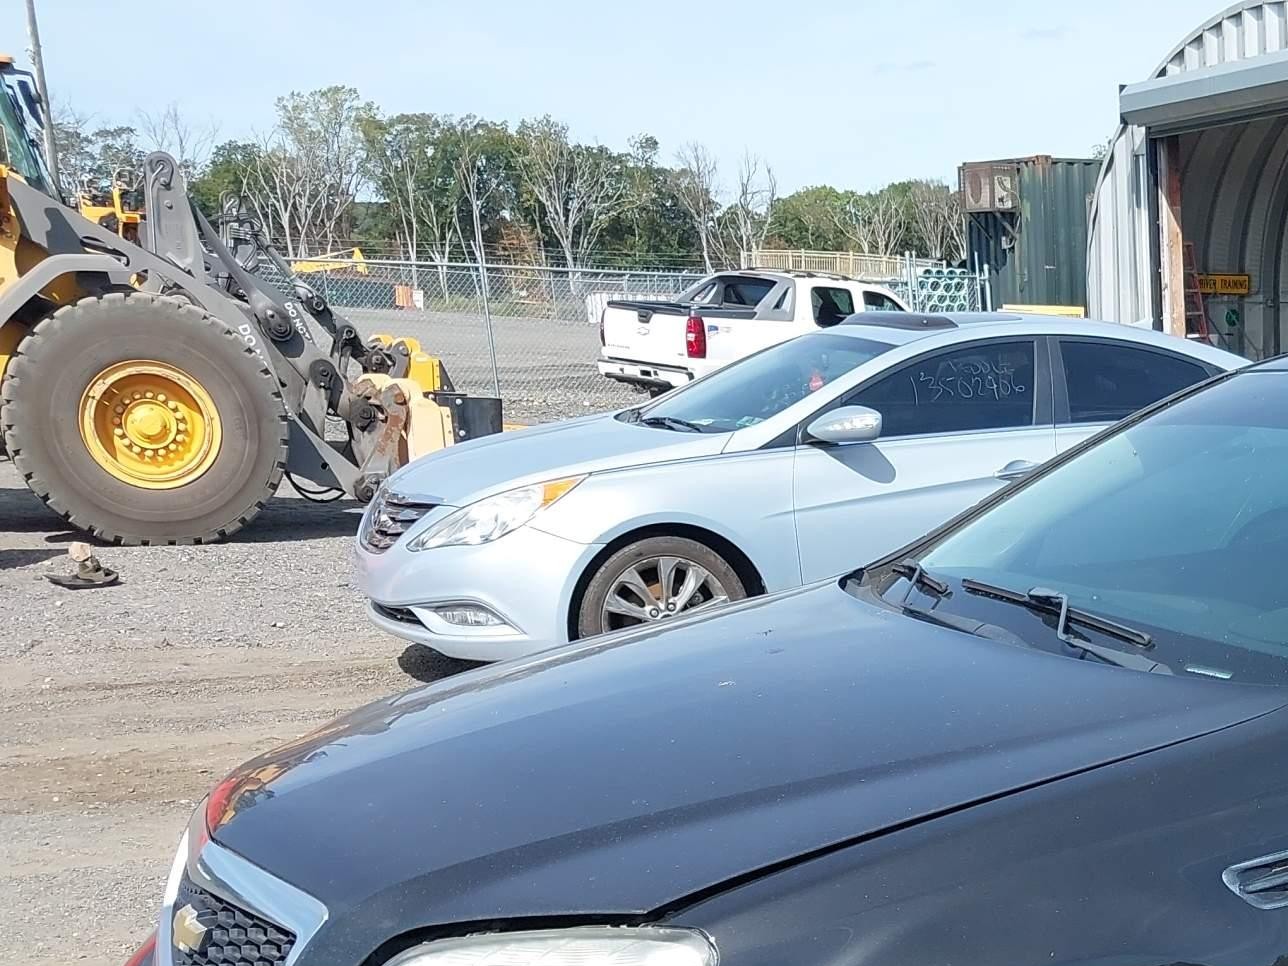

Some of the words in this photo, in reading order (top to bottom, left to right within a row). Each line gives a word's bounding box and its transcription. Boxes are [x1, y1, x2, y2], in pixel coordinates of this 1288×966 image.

[1197, 278, 1216, 290] RIVER
[1220, 279, 1248, 290] TRAINING
[284, 301, 297, 318] DO
[237, 323, 257, 347] DO
